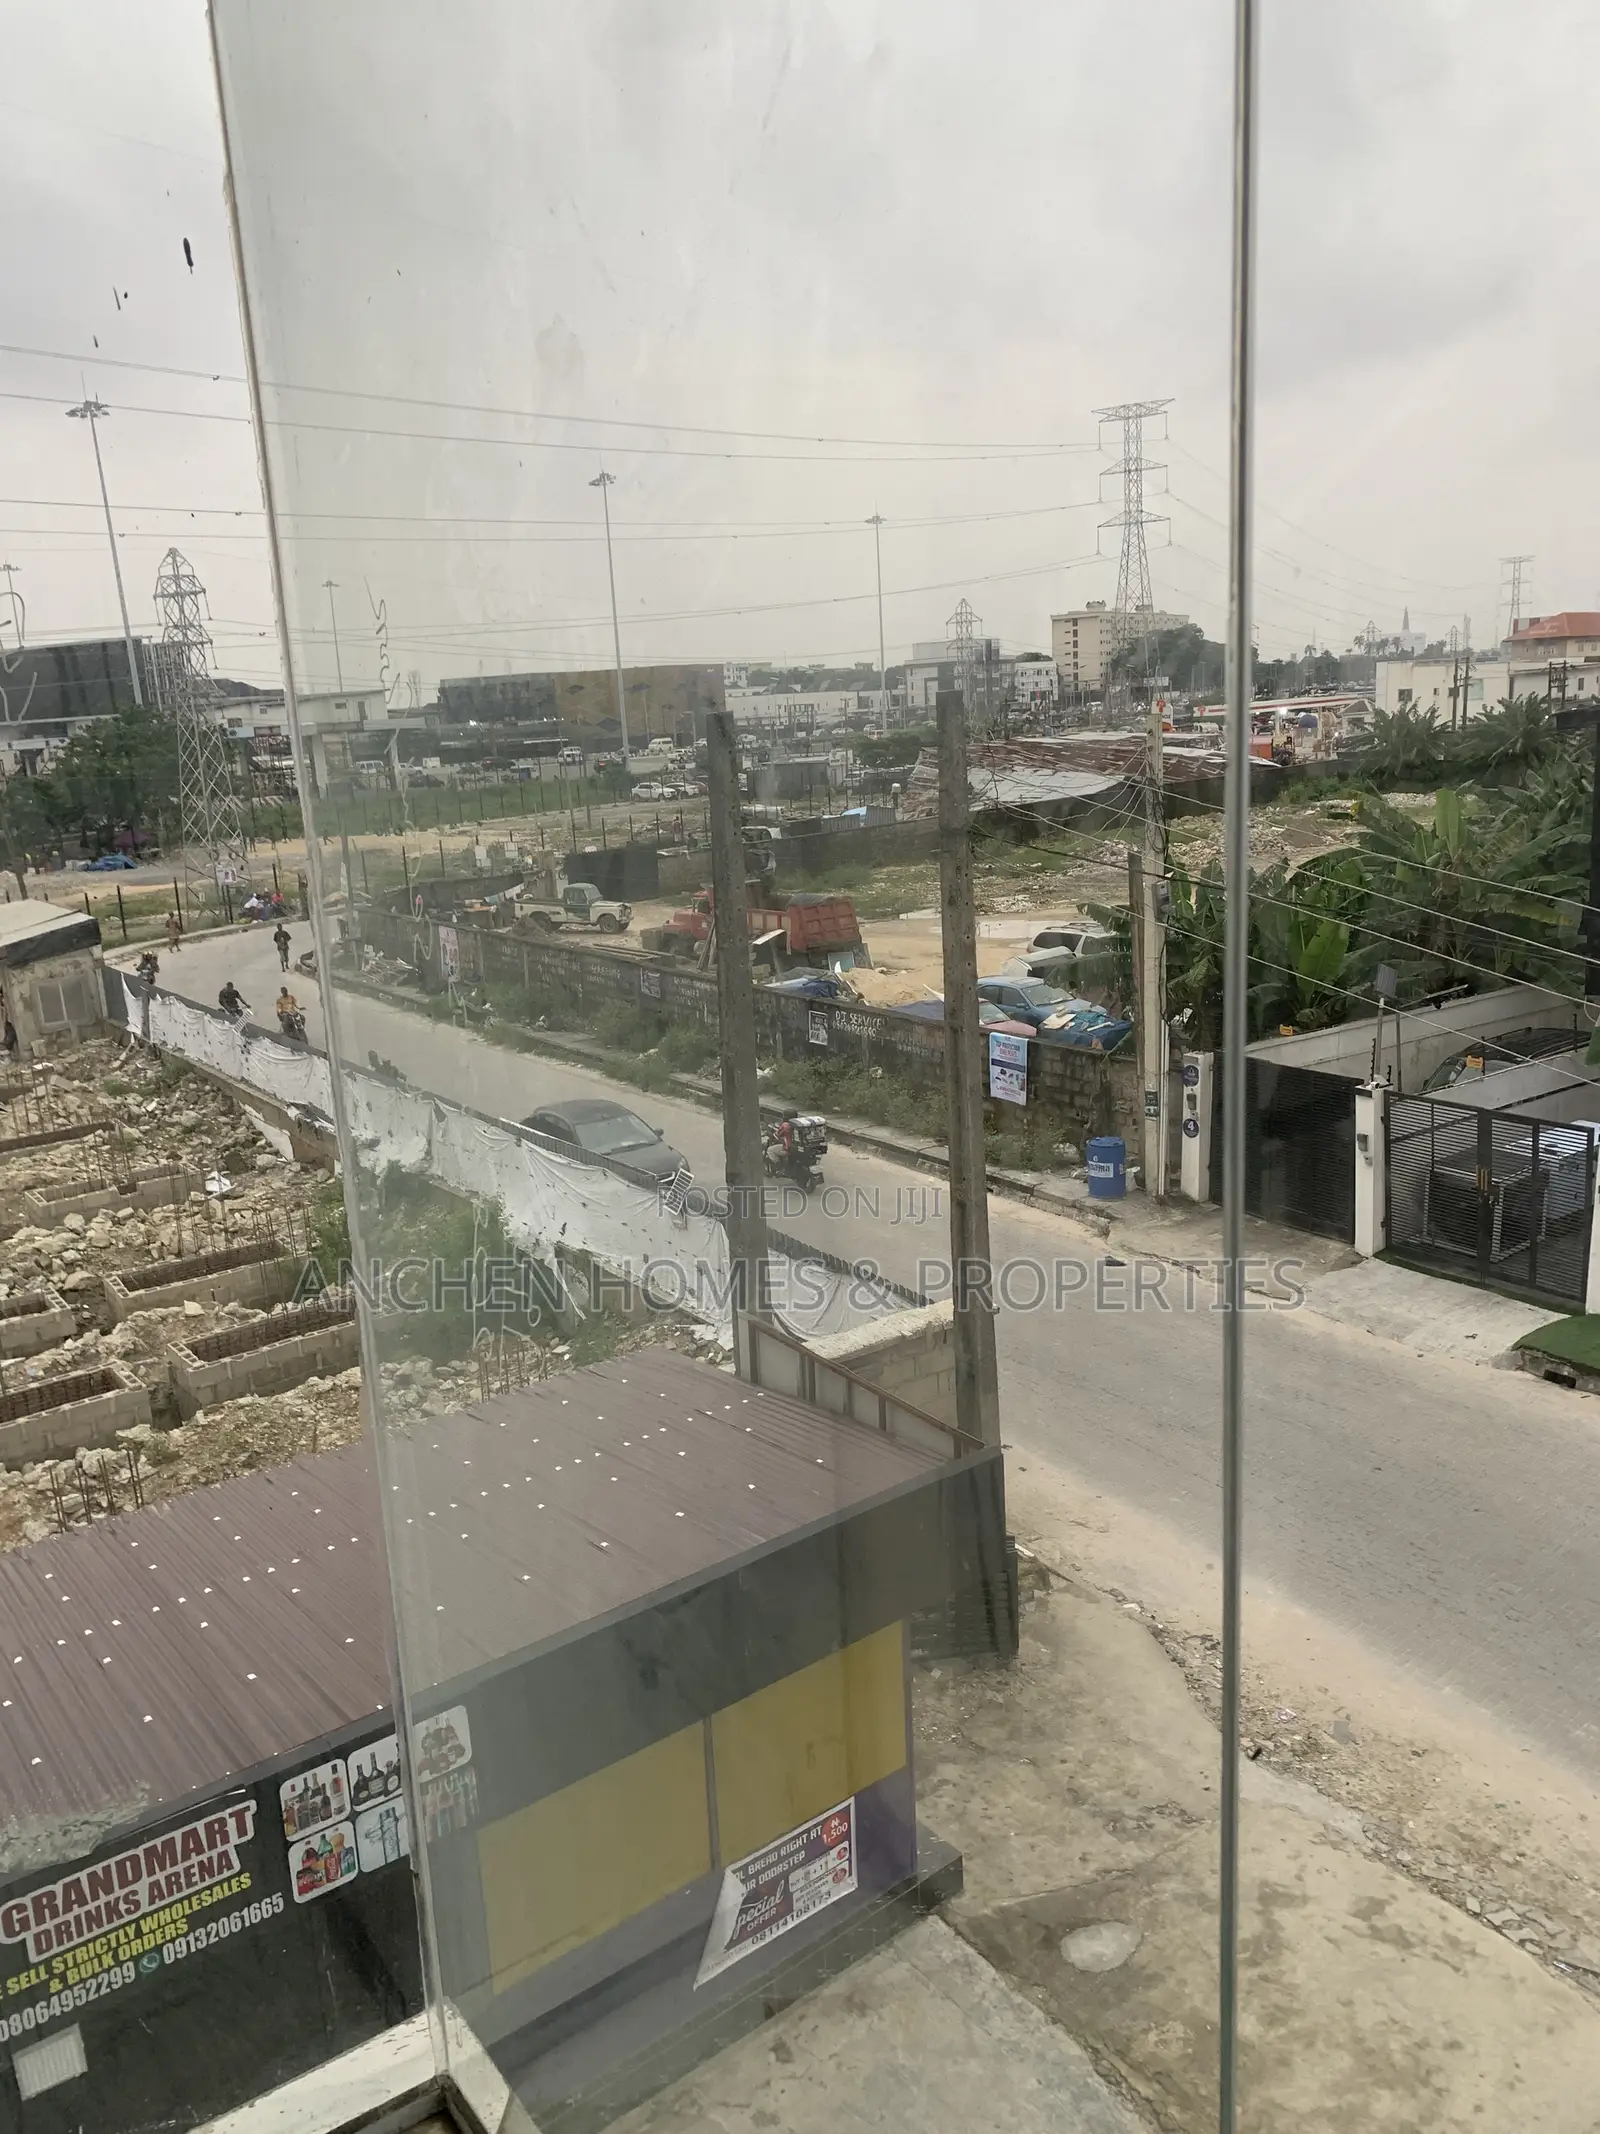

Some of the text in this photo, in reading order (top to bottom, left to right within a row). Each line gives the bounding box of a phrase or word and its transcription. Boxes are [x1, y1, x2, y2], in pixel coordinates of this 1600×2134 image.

[748, 1851, 778, 1876] BREAD
[780, 1835, 808, 1857] RIGHT
[810, 1826, 823, 1840] AT
[823, 1822, 848, 1844] 1,500
[2, 1804, 255, 1939] GRANDMART
[33, 1849, 235, 1957] DRINKS ARENA
[744, 1880, 756, 1893] UR
[758, 1851, 806, 1886] DOORSTEP
[6, 1963, 48, 1998] SELL
[53, 1922, 139, 1974] STRICTLY
[139, 1872, 252, 1936] WHOLESALES
[732, 1880, 785, 1940] pecial
[746, 1907, 778, 1932] OFFER
[0, 1892, 285, 2043] 08064952299 09132061665
[49, 1918, 189, 1994] & BULK ORDERS
